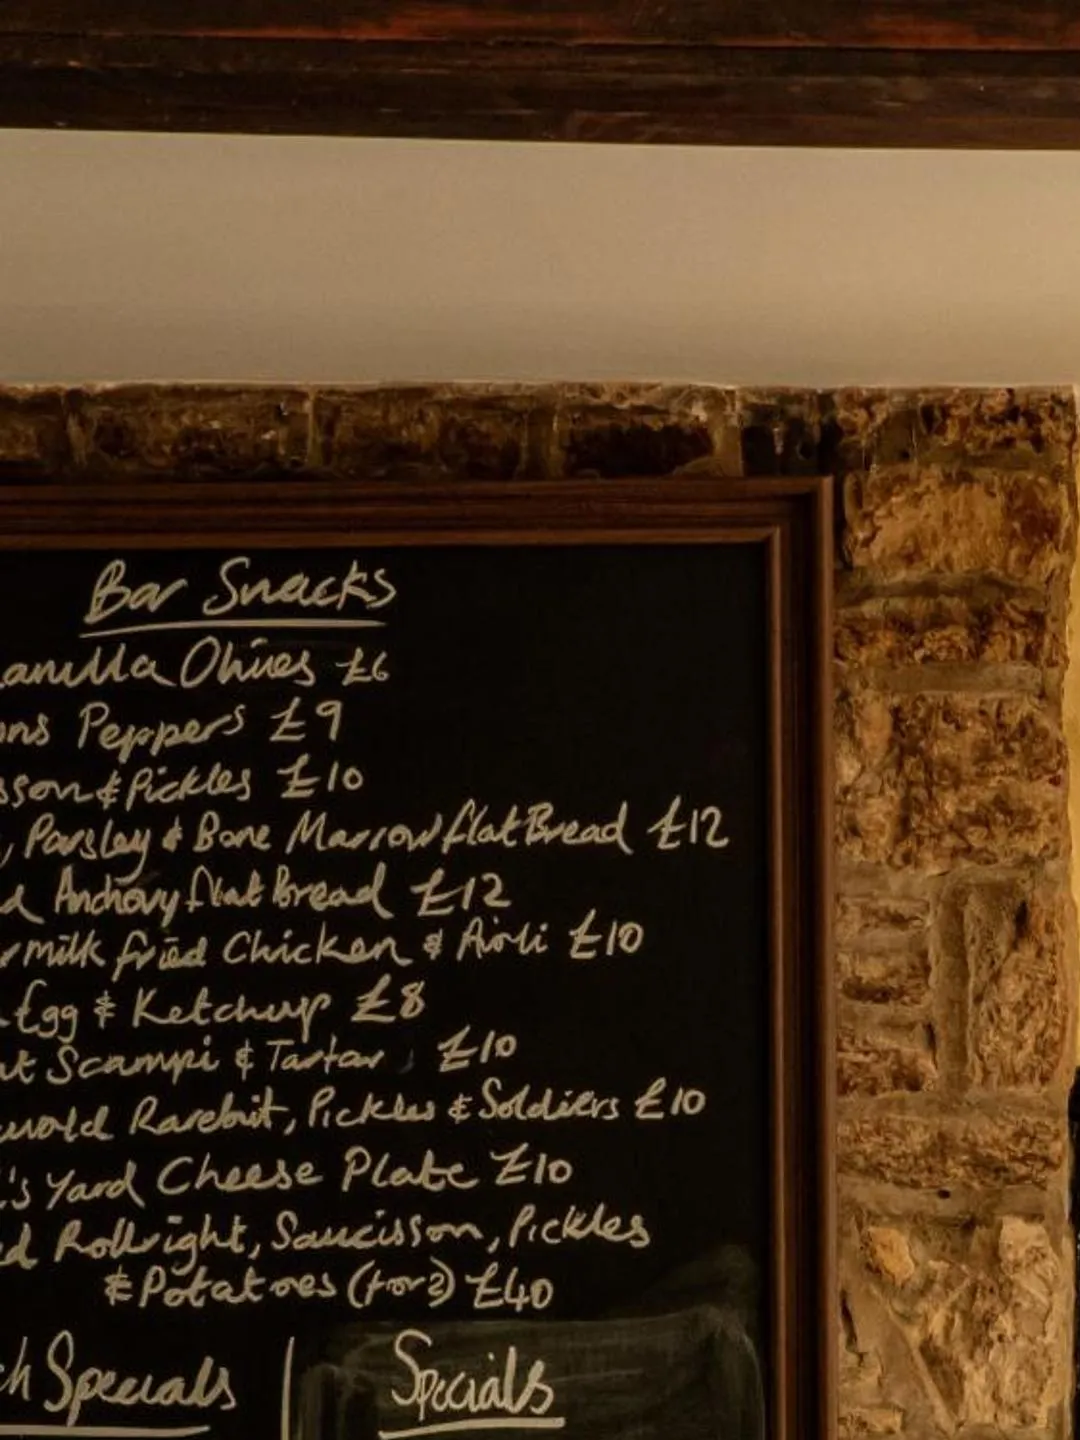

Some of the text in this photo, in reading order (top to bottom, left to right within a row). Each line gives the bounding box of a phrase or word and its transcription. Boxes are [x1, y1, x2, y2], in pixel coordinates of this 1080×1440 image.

[84, 556, 398, 624] Bar Snacks
[180, 636, 316, 688] Olives
[336, 648, 390, 686] £6
[78, 700, 245, 763] Peppers
[269, 697, 344, 742] £9
[126, 762, 251, 811] Pickles
[276, 753, 364, 798] £10
[24, 812, 152, 884] Parsley
[192, 811, 272, 853] Bone
[285, 809, 443, 854] Marrow
[647, 795, 730, 850] £12
[54, 865, 181, 928] Anchovy
[410, 868, 511, 916] £12
[223, 922, 413, 968] Chicken
[569, 908, 644, 959] £10
[15, 974, 425, 1043] Egg & Ketchup £8
[46, 1035, 220, 1086] Scampi
[235, 1040, 254, 1081] &
[266, 1034, 385, 1073] Tartar
[437, 1025, 517, 1072] £10
[0, 1076, 706, 1143] wold Rarebit, Pickles & Soldiers £10
[0, 1141, 572, 1210] 's Yard Cheese Plate £10
[54, 1213, 260, 1276] Rollright,
[271, 1210, 499, 1252] Saucisson,
[509, 1204, 650, 1249] Pickles
[104, 1264, 133, 1306] &
[139, 1264, 338, 1308] Potatoes
[465, 1262, 554, 1312] £40
[43, 1329, 237, 1427] Specials
[391, 1328, 555, 1421] Specials
